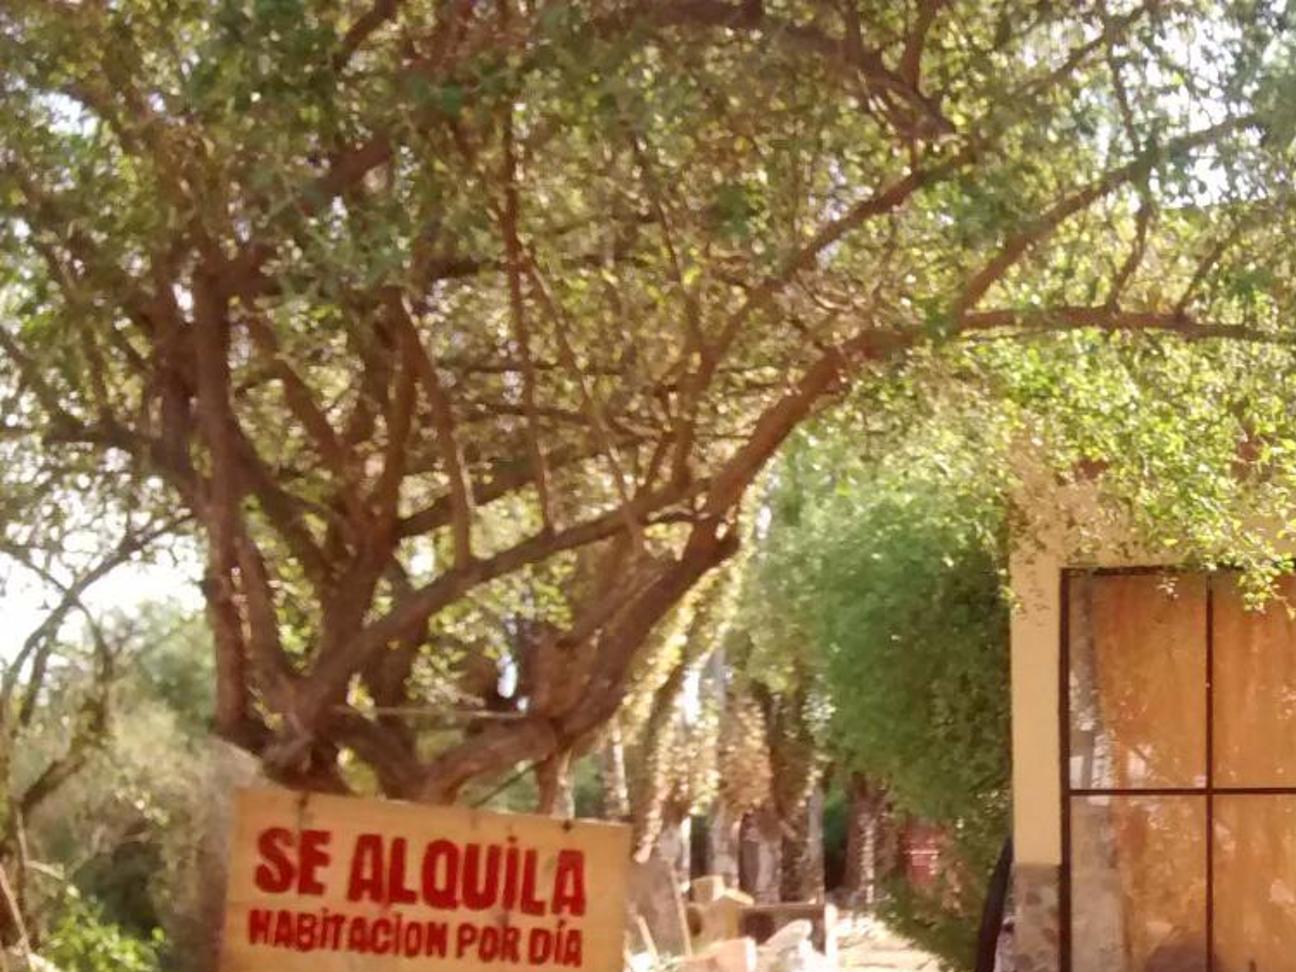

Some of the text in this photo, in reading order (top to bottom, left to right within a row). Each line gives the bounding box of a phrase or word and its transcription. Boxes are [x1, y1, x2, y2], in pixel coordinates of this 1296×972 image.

[254, 827, 586, 917] SE ALQUILA
[455, 922, 520, 965] POR
[528, 919, 583, 968] DÍA
